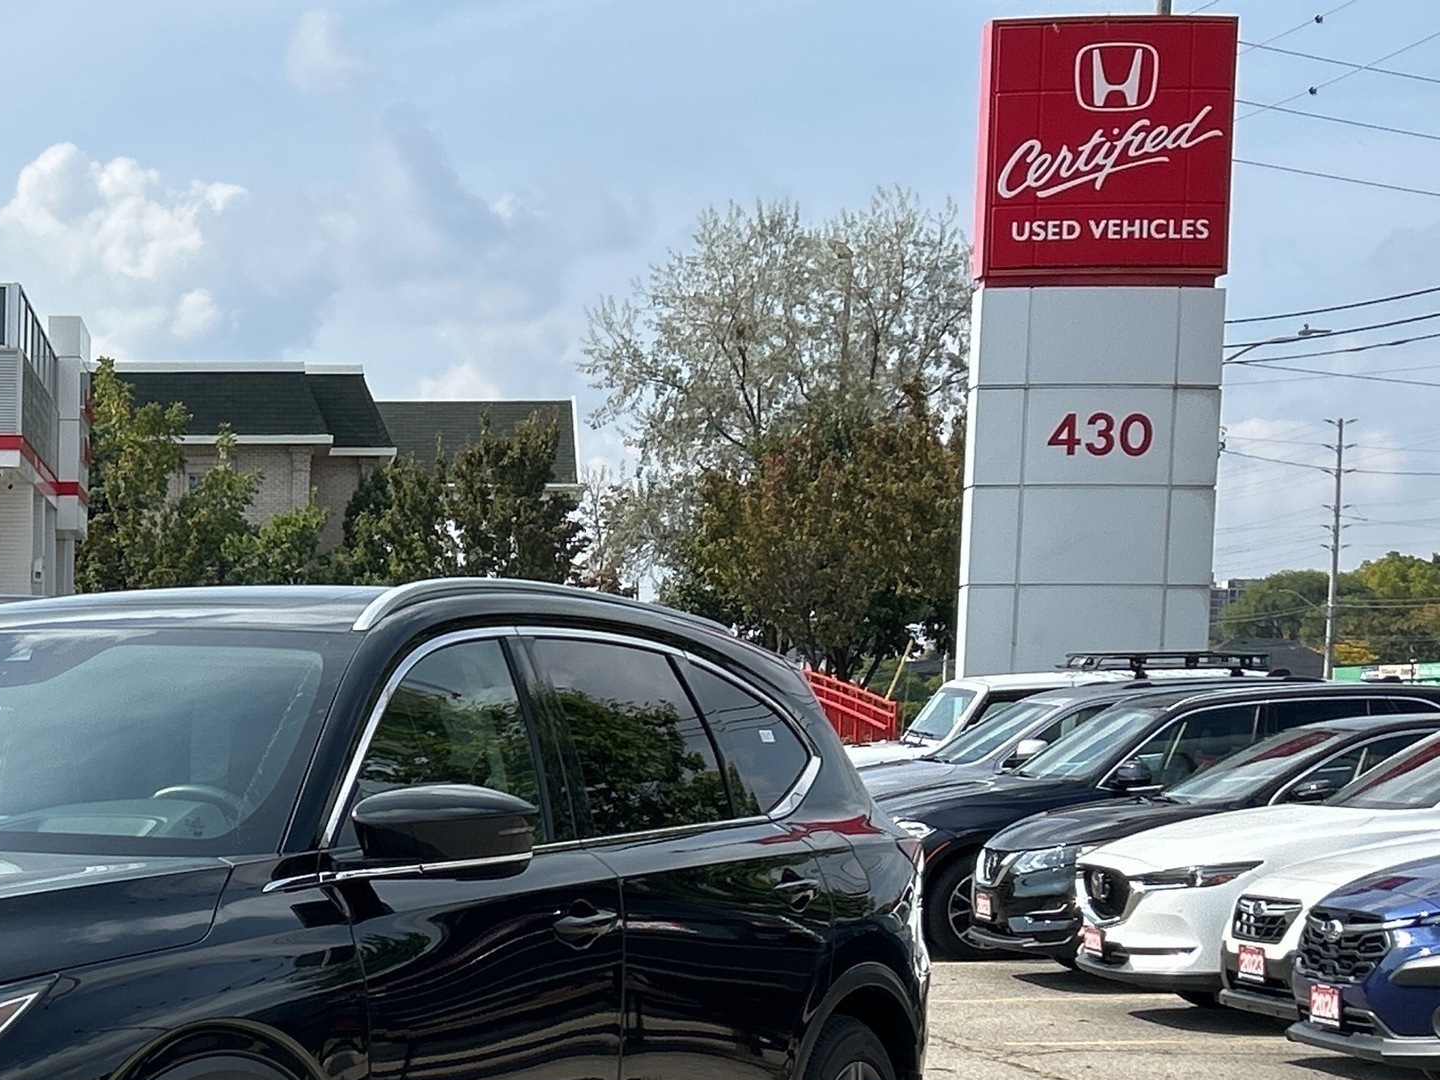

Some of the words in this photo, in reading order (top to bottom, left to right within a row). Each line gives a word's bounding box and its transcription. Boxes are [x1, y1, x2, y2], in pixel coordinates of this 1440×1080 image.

[997, 105, 1222, 198] Certified
[1011, 219, 1081, 241] USED
[1088, 218, 1210, 240] VEHICLES
[1047, 412, 1154, 457] 430
[1311, 992, 1340, 1019] 2024
